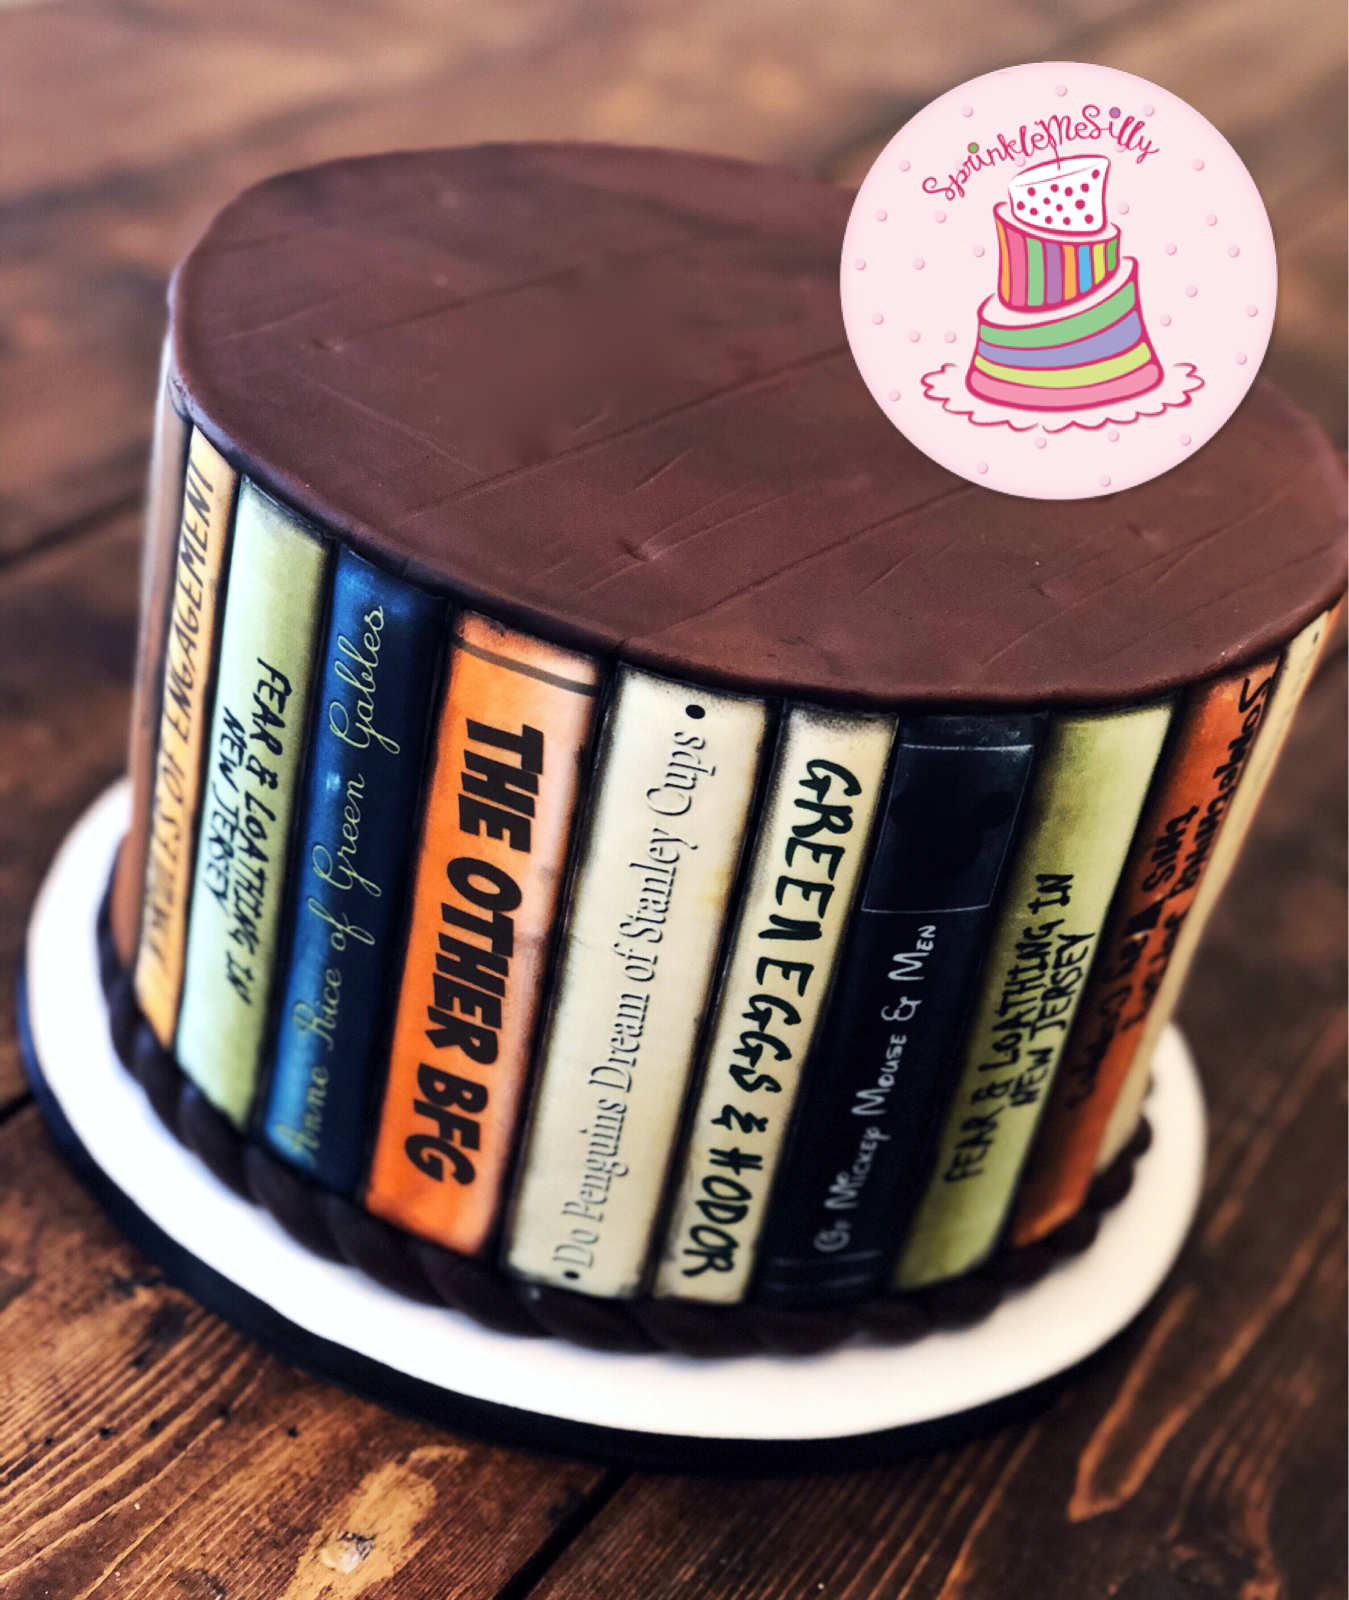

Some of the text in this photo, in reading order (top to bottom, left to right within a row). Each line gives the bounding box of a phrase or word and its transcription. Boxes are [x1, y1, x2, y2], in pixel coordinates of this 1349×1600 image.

[166, 457, 214, 744] ENGAGEMENT
[203, 706, 248, 918] NEW JERSEY
[227, 657, 292, 1005] FEAR & LOATHING IN
[272, 605, 400, 1168] Anne Rice of Green Gables
[403, 717, 544, 1188] THE OTHER BFG
[552, 731, 716, 1269] Do Penguins Dream of Stanley Cups
[682, 758, 862, 1278] GREEN EGGS & HODOR
[881, 995, 923, 1021] &
[943, 873, 1075, 1184] FEAR & LOATHING IN
[1010, 932, 1096, 1108] NEW JERSEY
